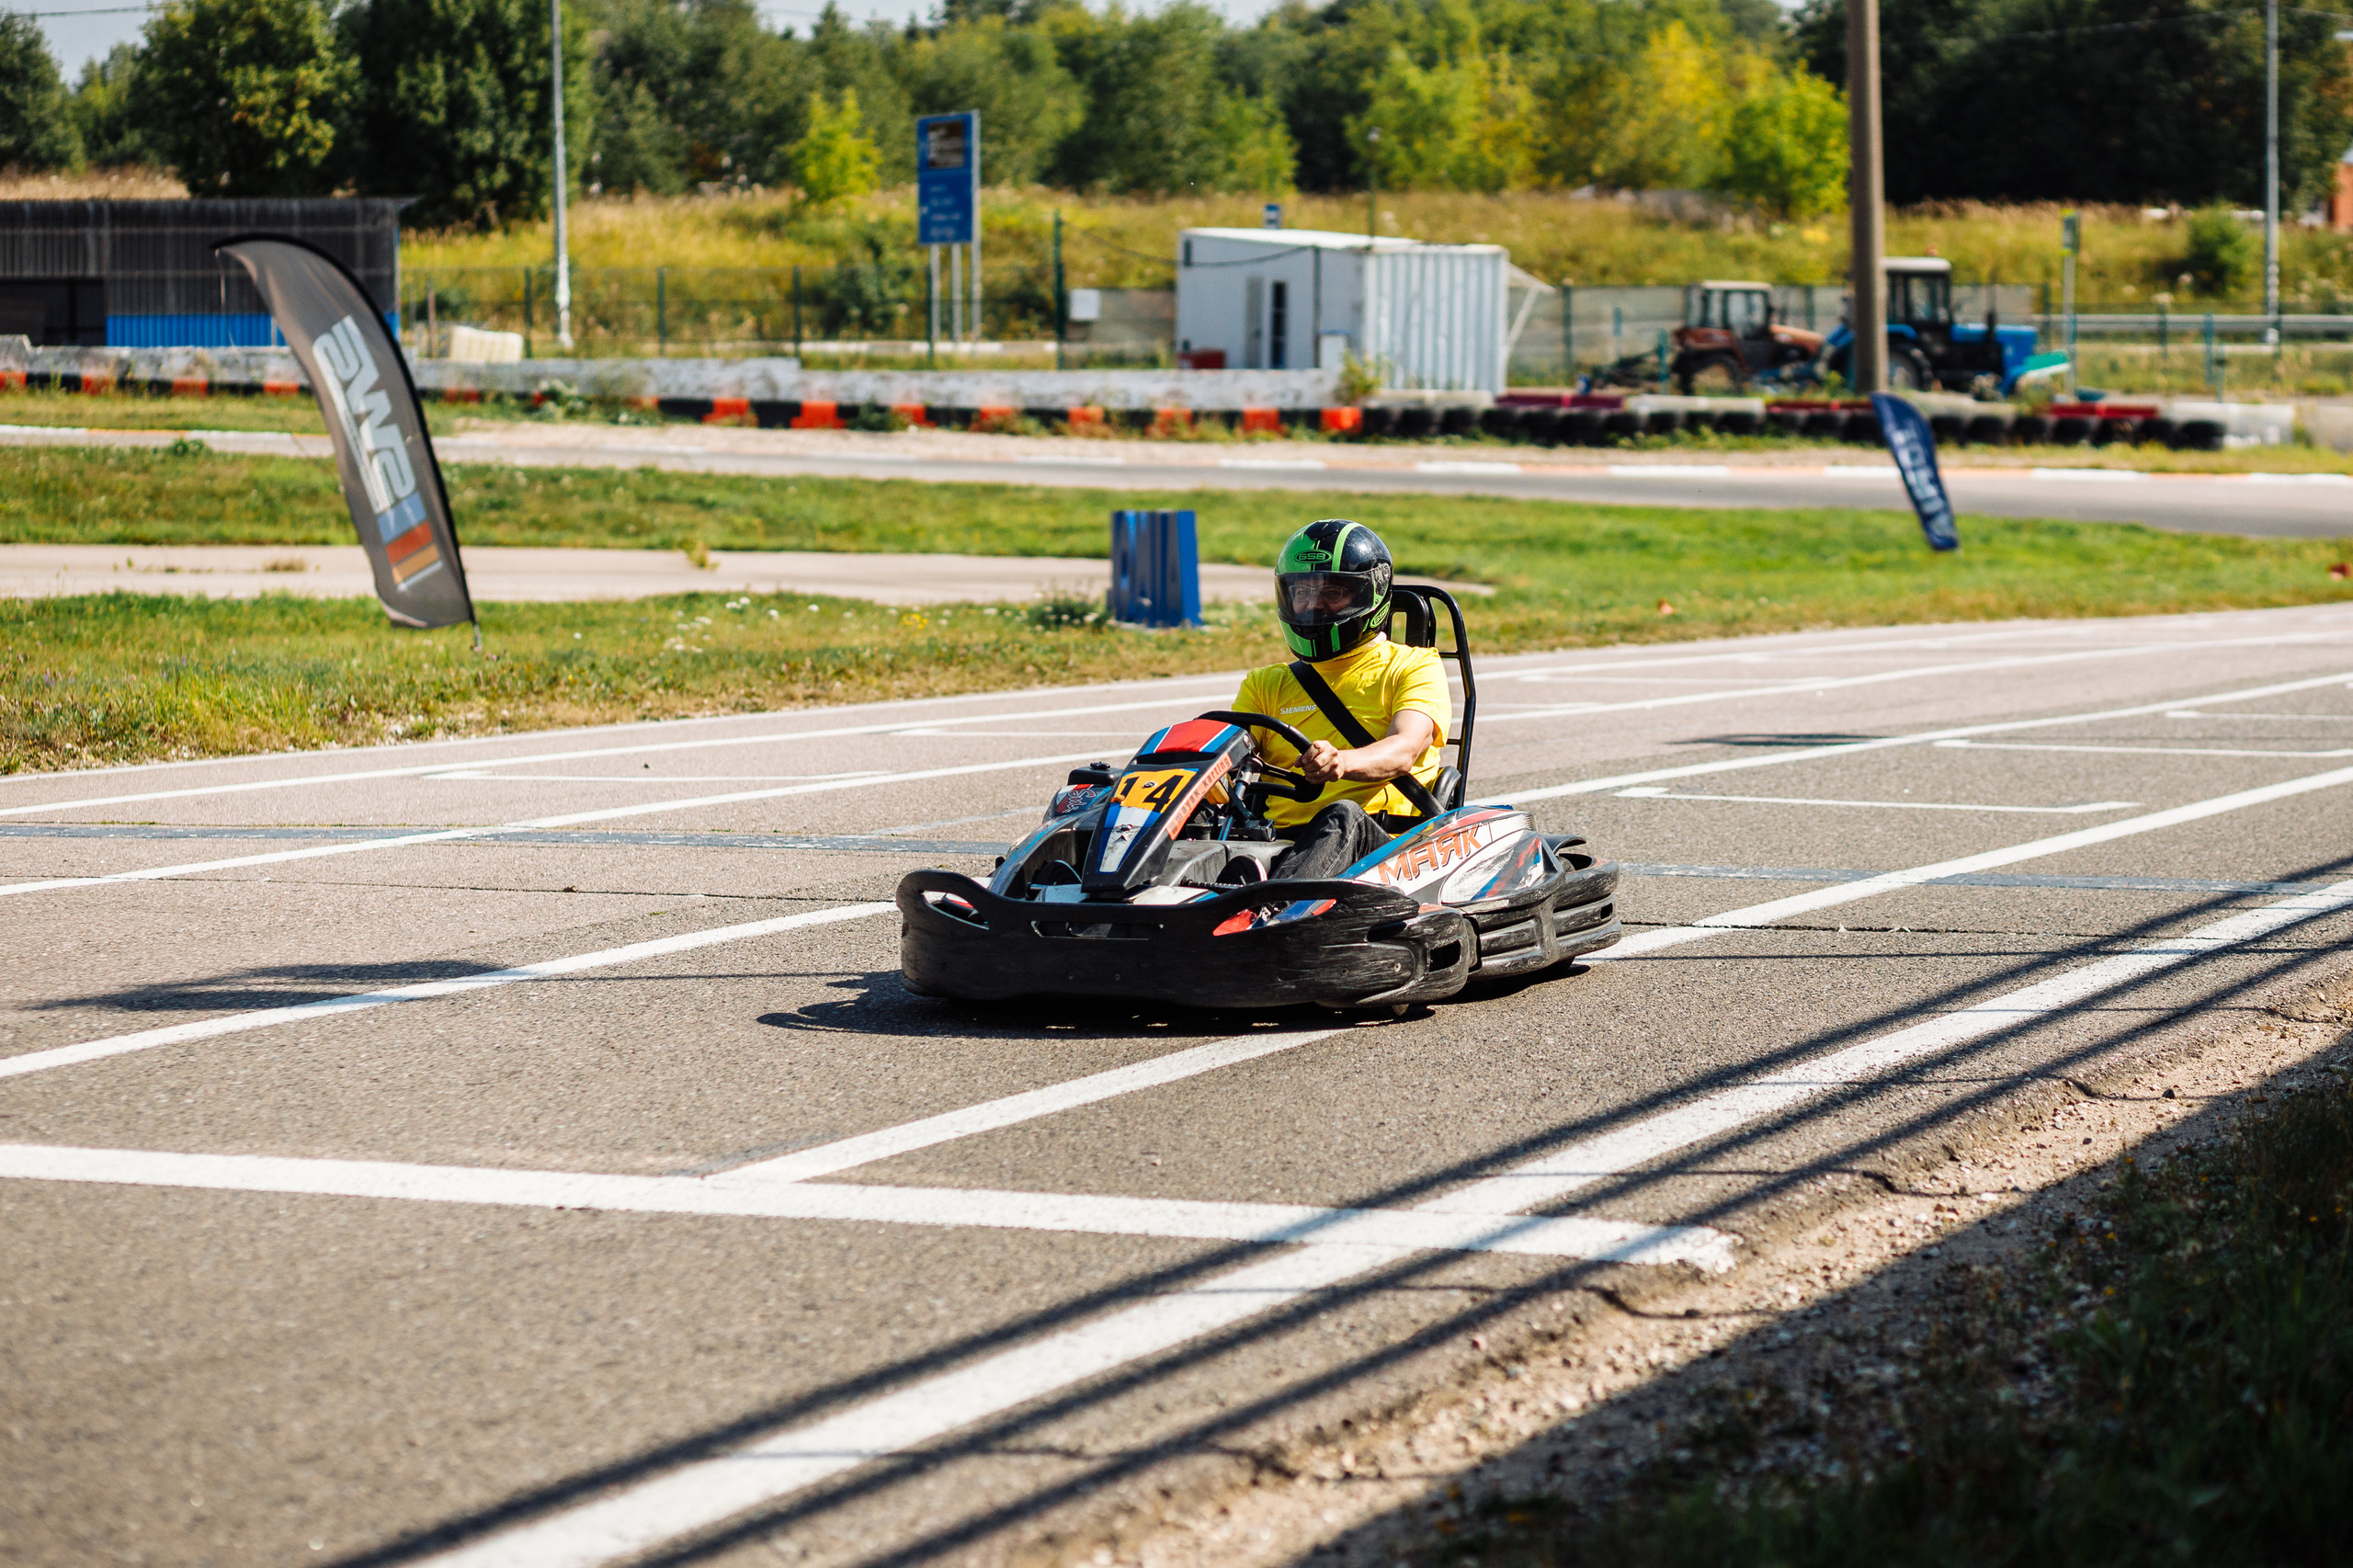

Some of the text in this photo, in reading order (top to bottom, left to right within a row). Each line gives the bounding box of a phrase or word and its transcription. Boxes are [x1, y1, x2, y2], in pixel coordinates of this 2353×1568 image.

[1279, 704, 1317, 715] SIEMENS
[1120, 774, 1184, 813] 14
[1378, 824, 1483, 885] МАЯК
